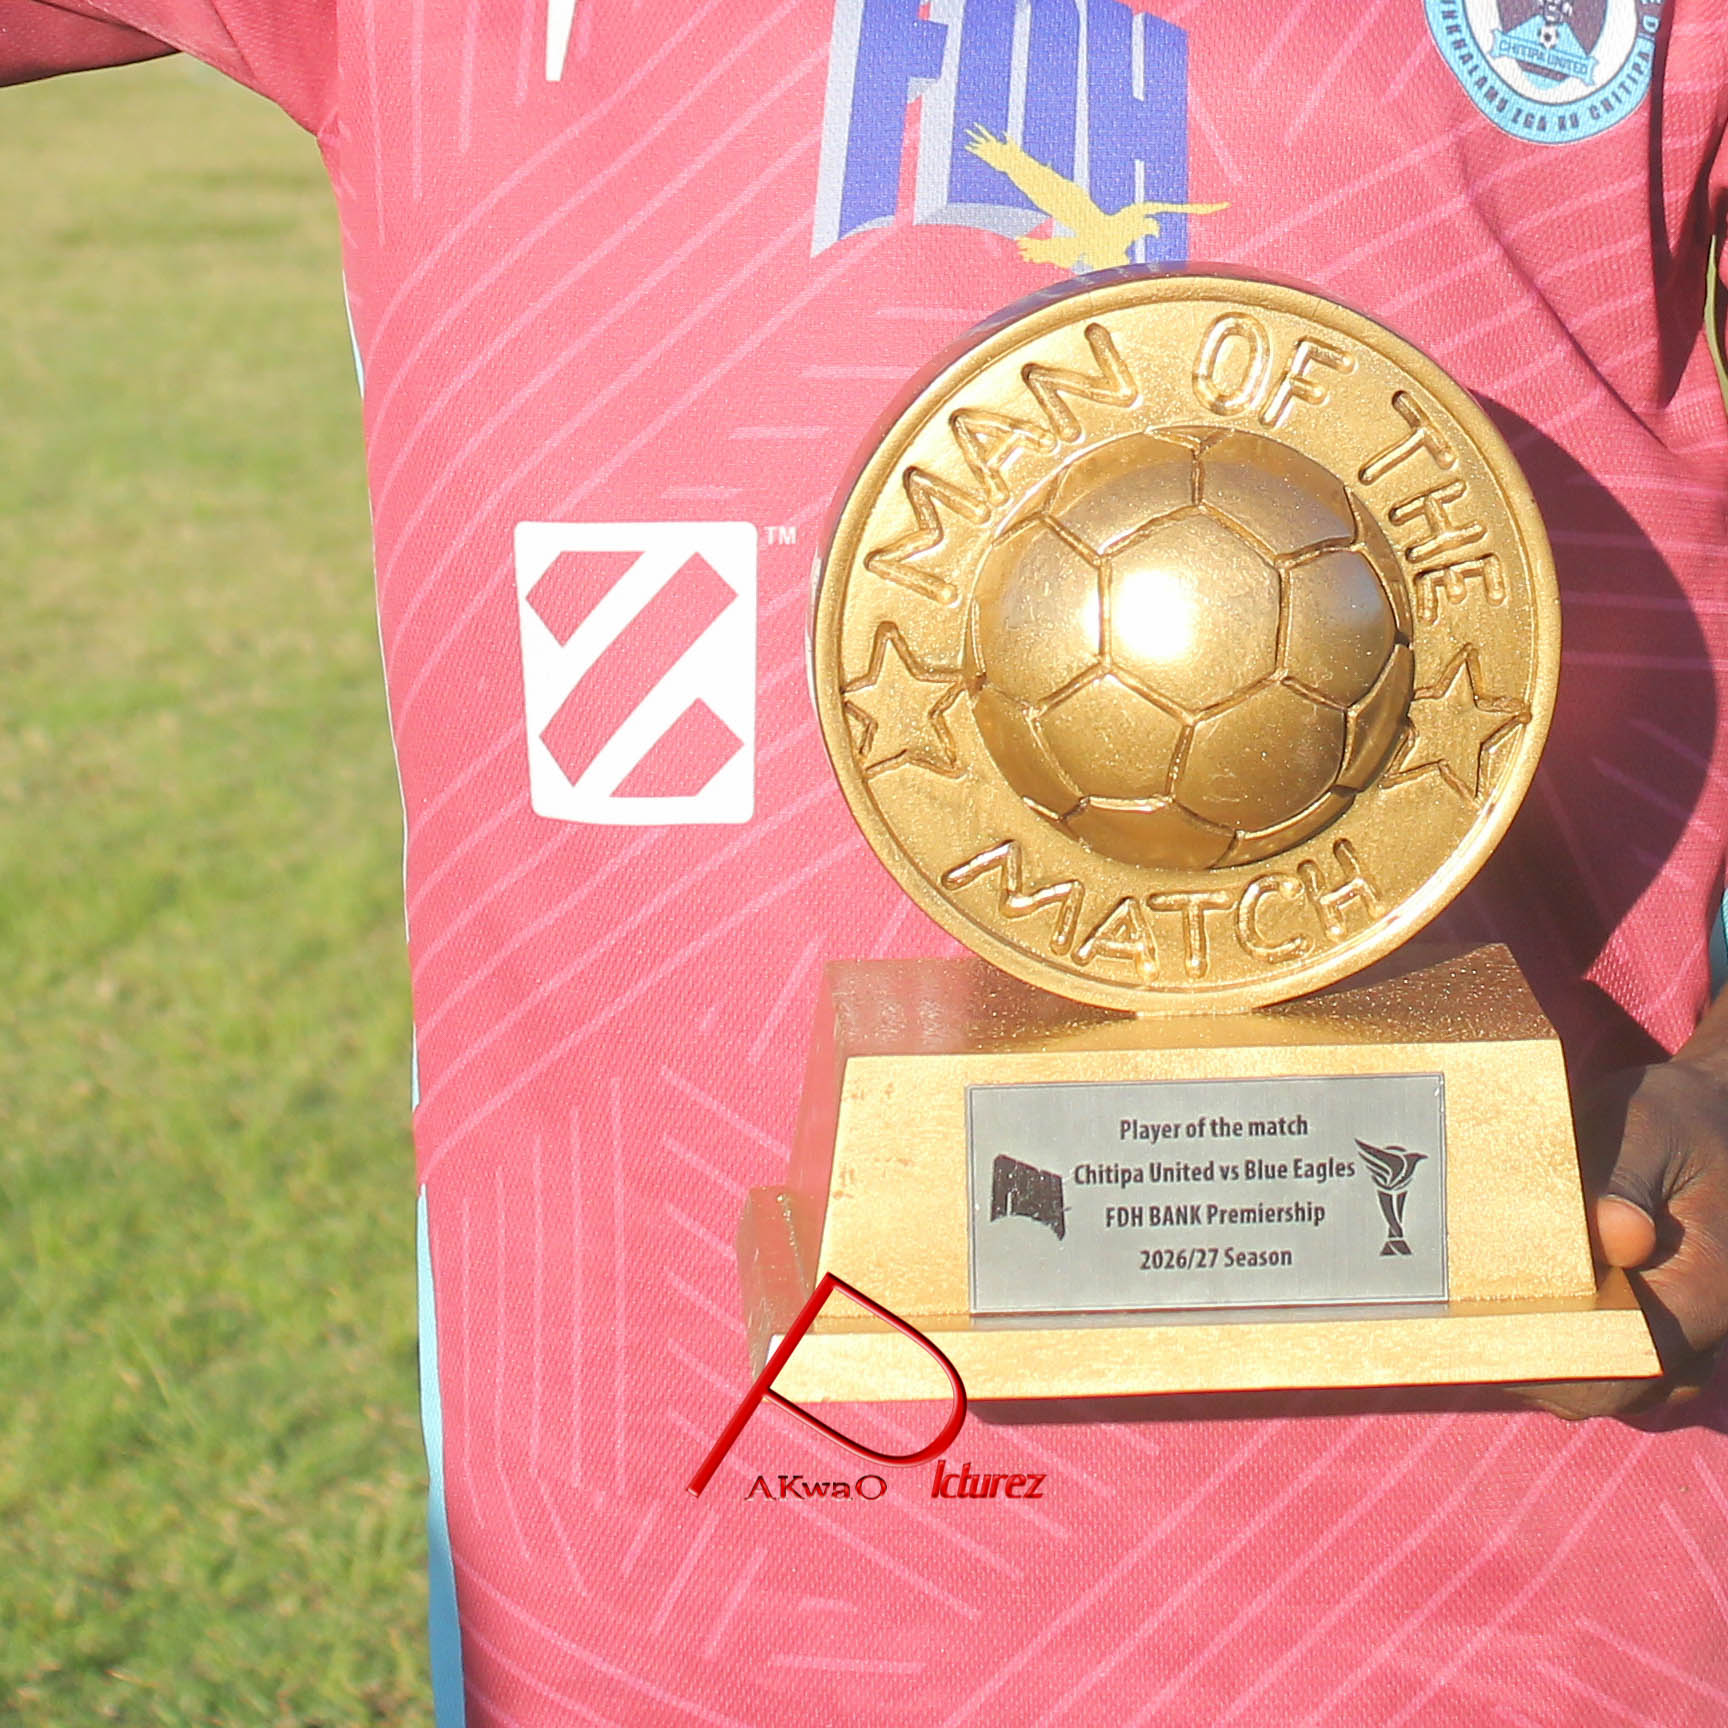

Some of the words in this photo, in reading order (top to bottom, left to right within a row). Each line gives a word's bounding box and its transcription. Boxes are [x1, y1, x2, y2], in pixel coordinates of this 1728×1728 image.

[864, 322, 1143, 607] MAN
[1191, 311, 1357, 427] OF
[1358, 389, 1506, 625] THE
[764, 526, 797, 545] TM
[942, 838, 1382, 979] MATCH
[1120, 1119, 1181, 1144] Player
[1186, 1116, 1208, 1138] of
[1210, 1117, 1243, 1138] the
[1248, 1115, 1308, 1136] match
[1074, 1163, 1144, 1189] Chitipa
[1149, 1161, 1215, 1183] United
[1219, 1165, 1239, 1181] vs
[1244, 1159, 1287, 1180] Blue
[1293, 1157, 1356, 1184] Eagles
[1105, 1206, 1143, 1228] FDH
[1149, 1204, 1203, 1227] BANK
[1206, 1201, 1326, 1227] Premiership
[1139, 1248, 1219, 1270] 2026/27
[1224, 1247, 1293, 1268] Season
